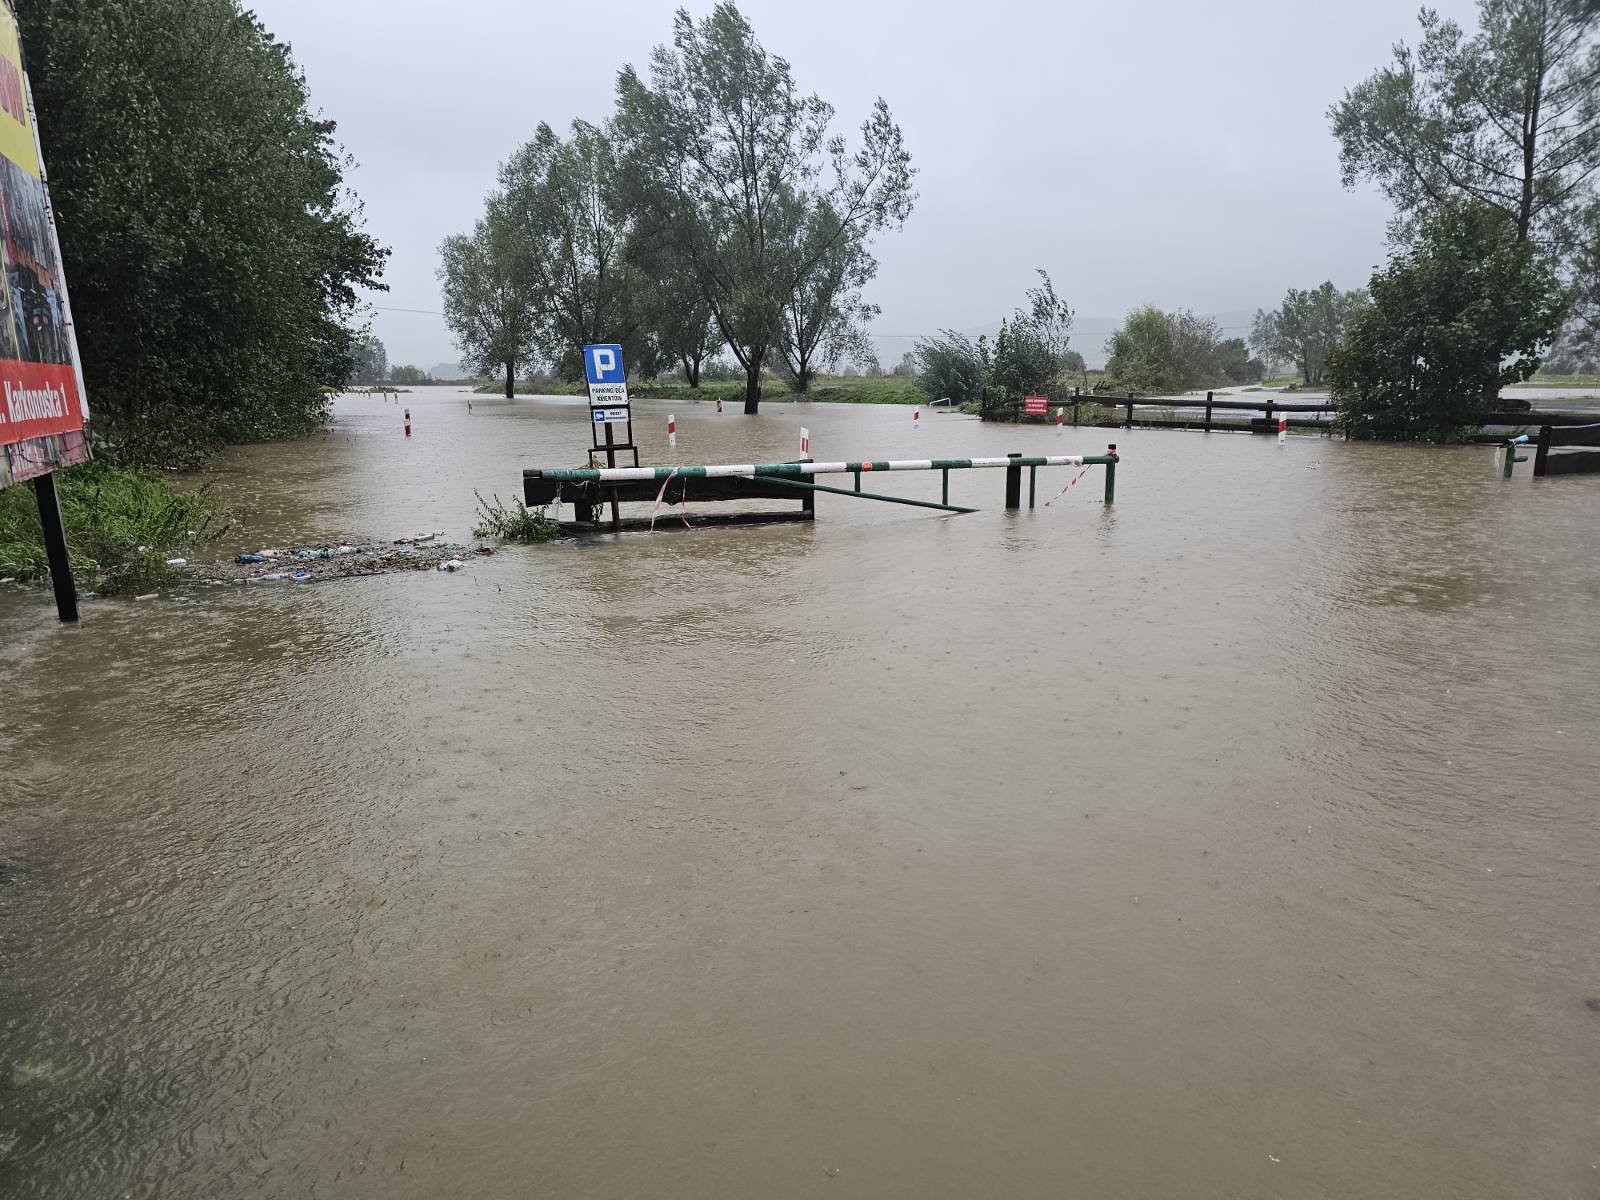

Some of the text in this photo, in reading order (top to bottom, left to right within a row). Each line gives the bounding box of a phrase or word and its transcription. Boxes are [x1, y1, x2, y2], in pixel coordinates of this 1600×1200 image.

[592, 348, 616, 380] P
[4, 380, 69, 423] Karkonoska 1
